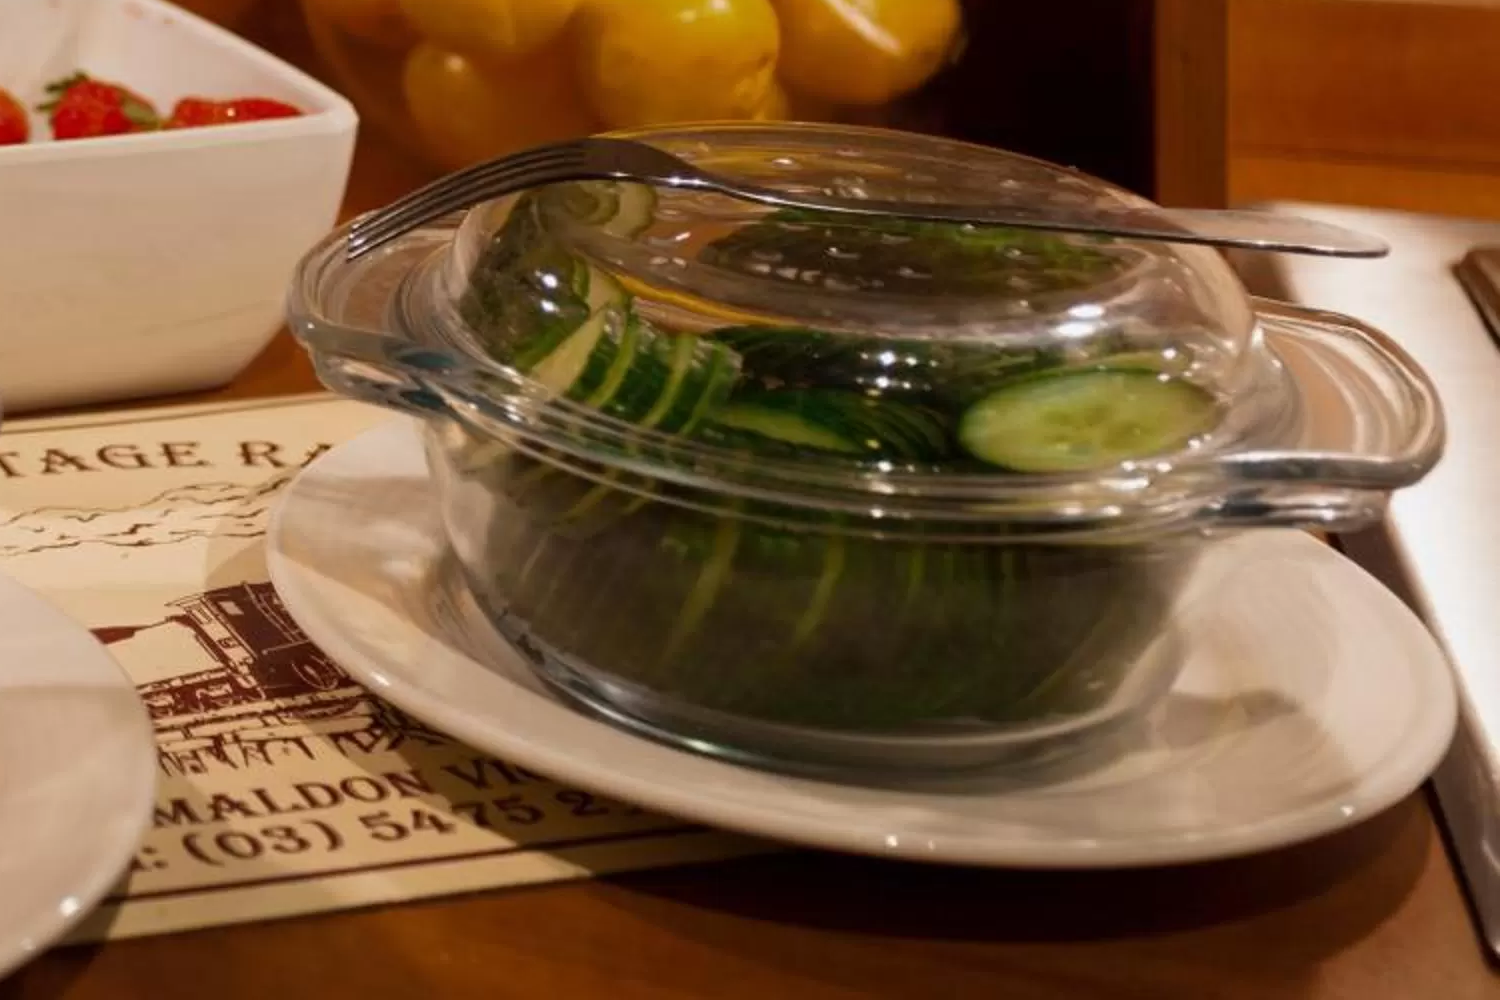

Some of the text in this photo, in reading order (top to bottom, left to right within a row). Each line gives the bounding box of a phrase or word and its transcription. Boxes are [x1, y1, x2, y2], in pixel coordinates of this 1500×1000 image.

[153, 756, 548, 828] MALDON VI
[181, 818, 345, 869] (03)
[359, 795, 545, 843] 5475
